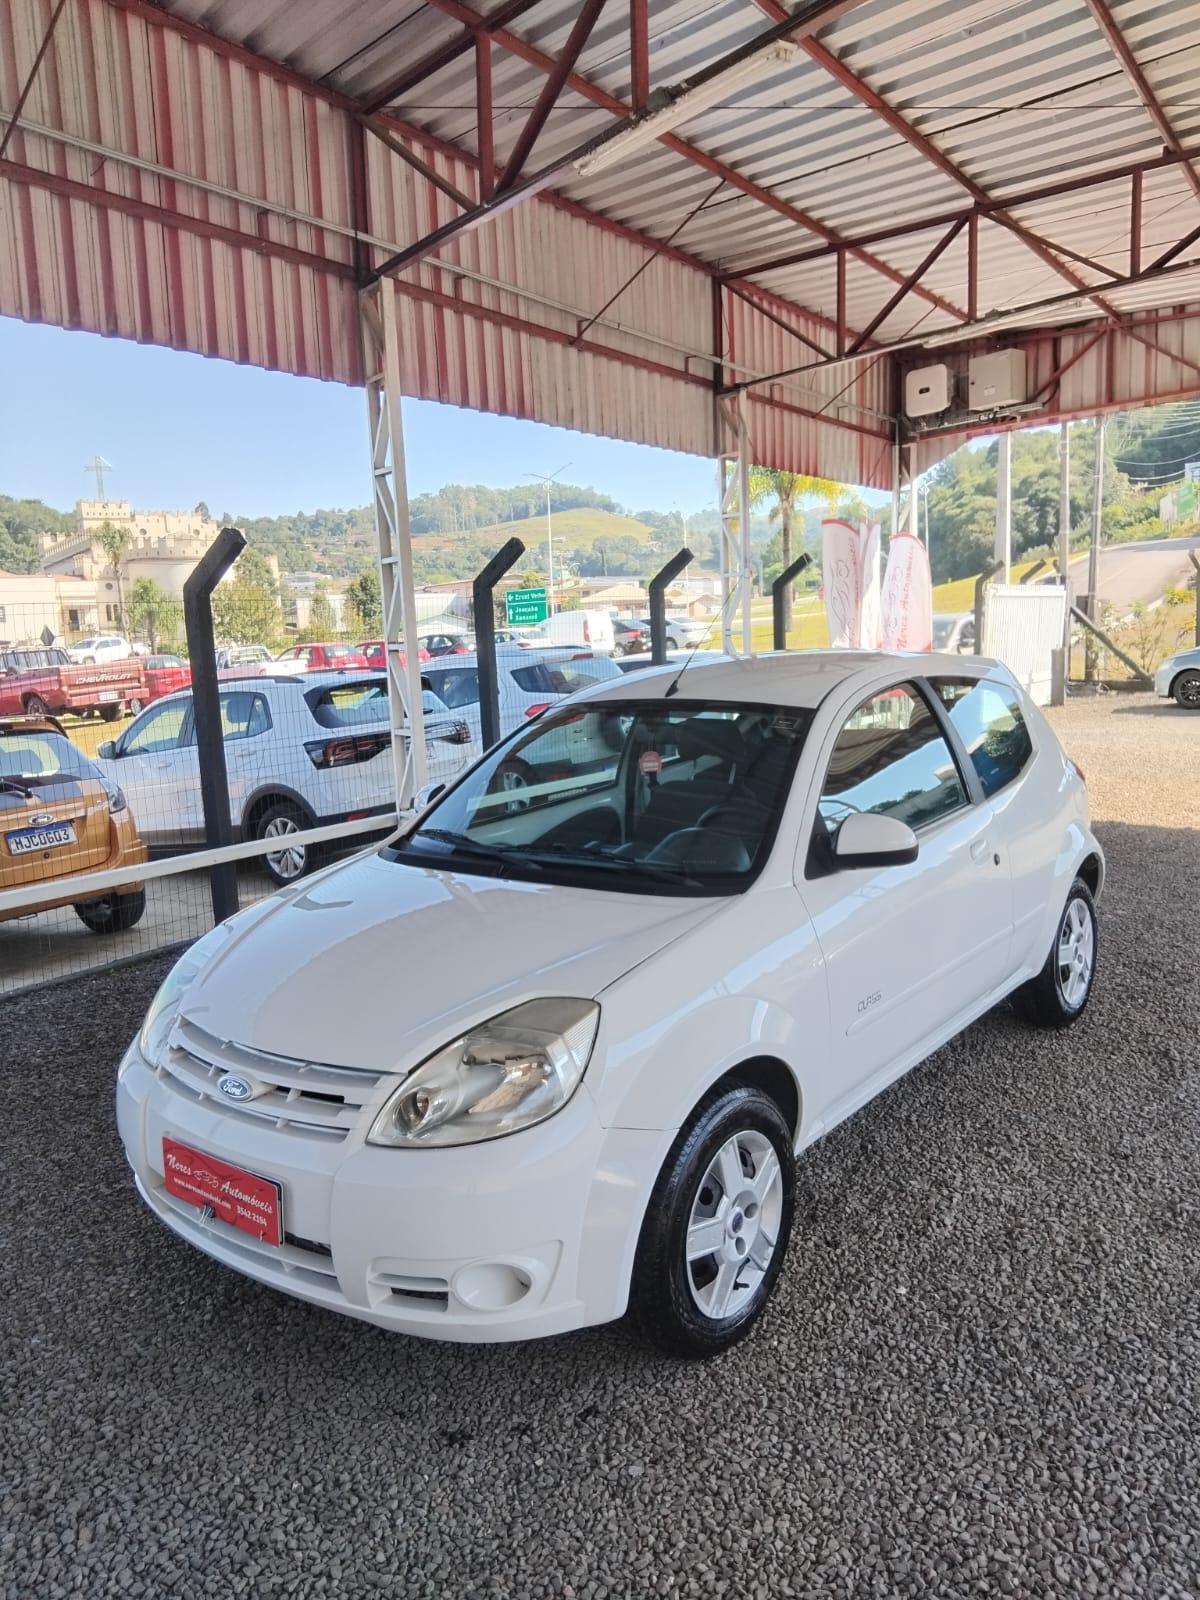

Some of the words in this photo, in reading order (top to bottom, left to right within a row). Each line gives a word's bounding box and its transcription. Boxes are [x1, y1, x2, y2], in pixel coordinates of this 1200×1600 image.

[76, 673, 132, 685] CHEVROLET
[166, 1153, 193, 1176] Neres
[220, 1180, 273, 1214] Automóveis
